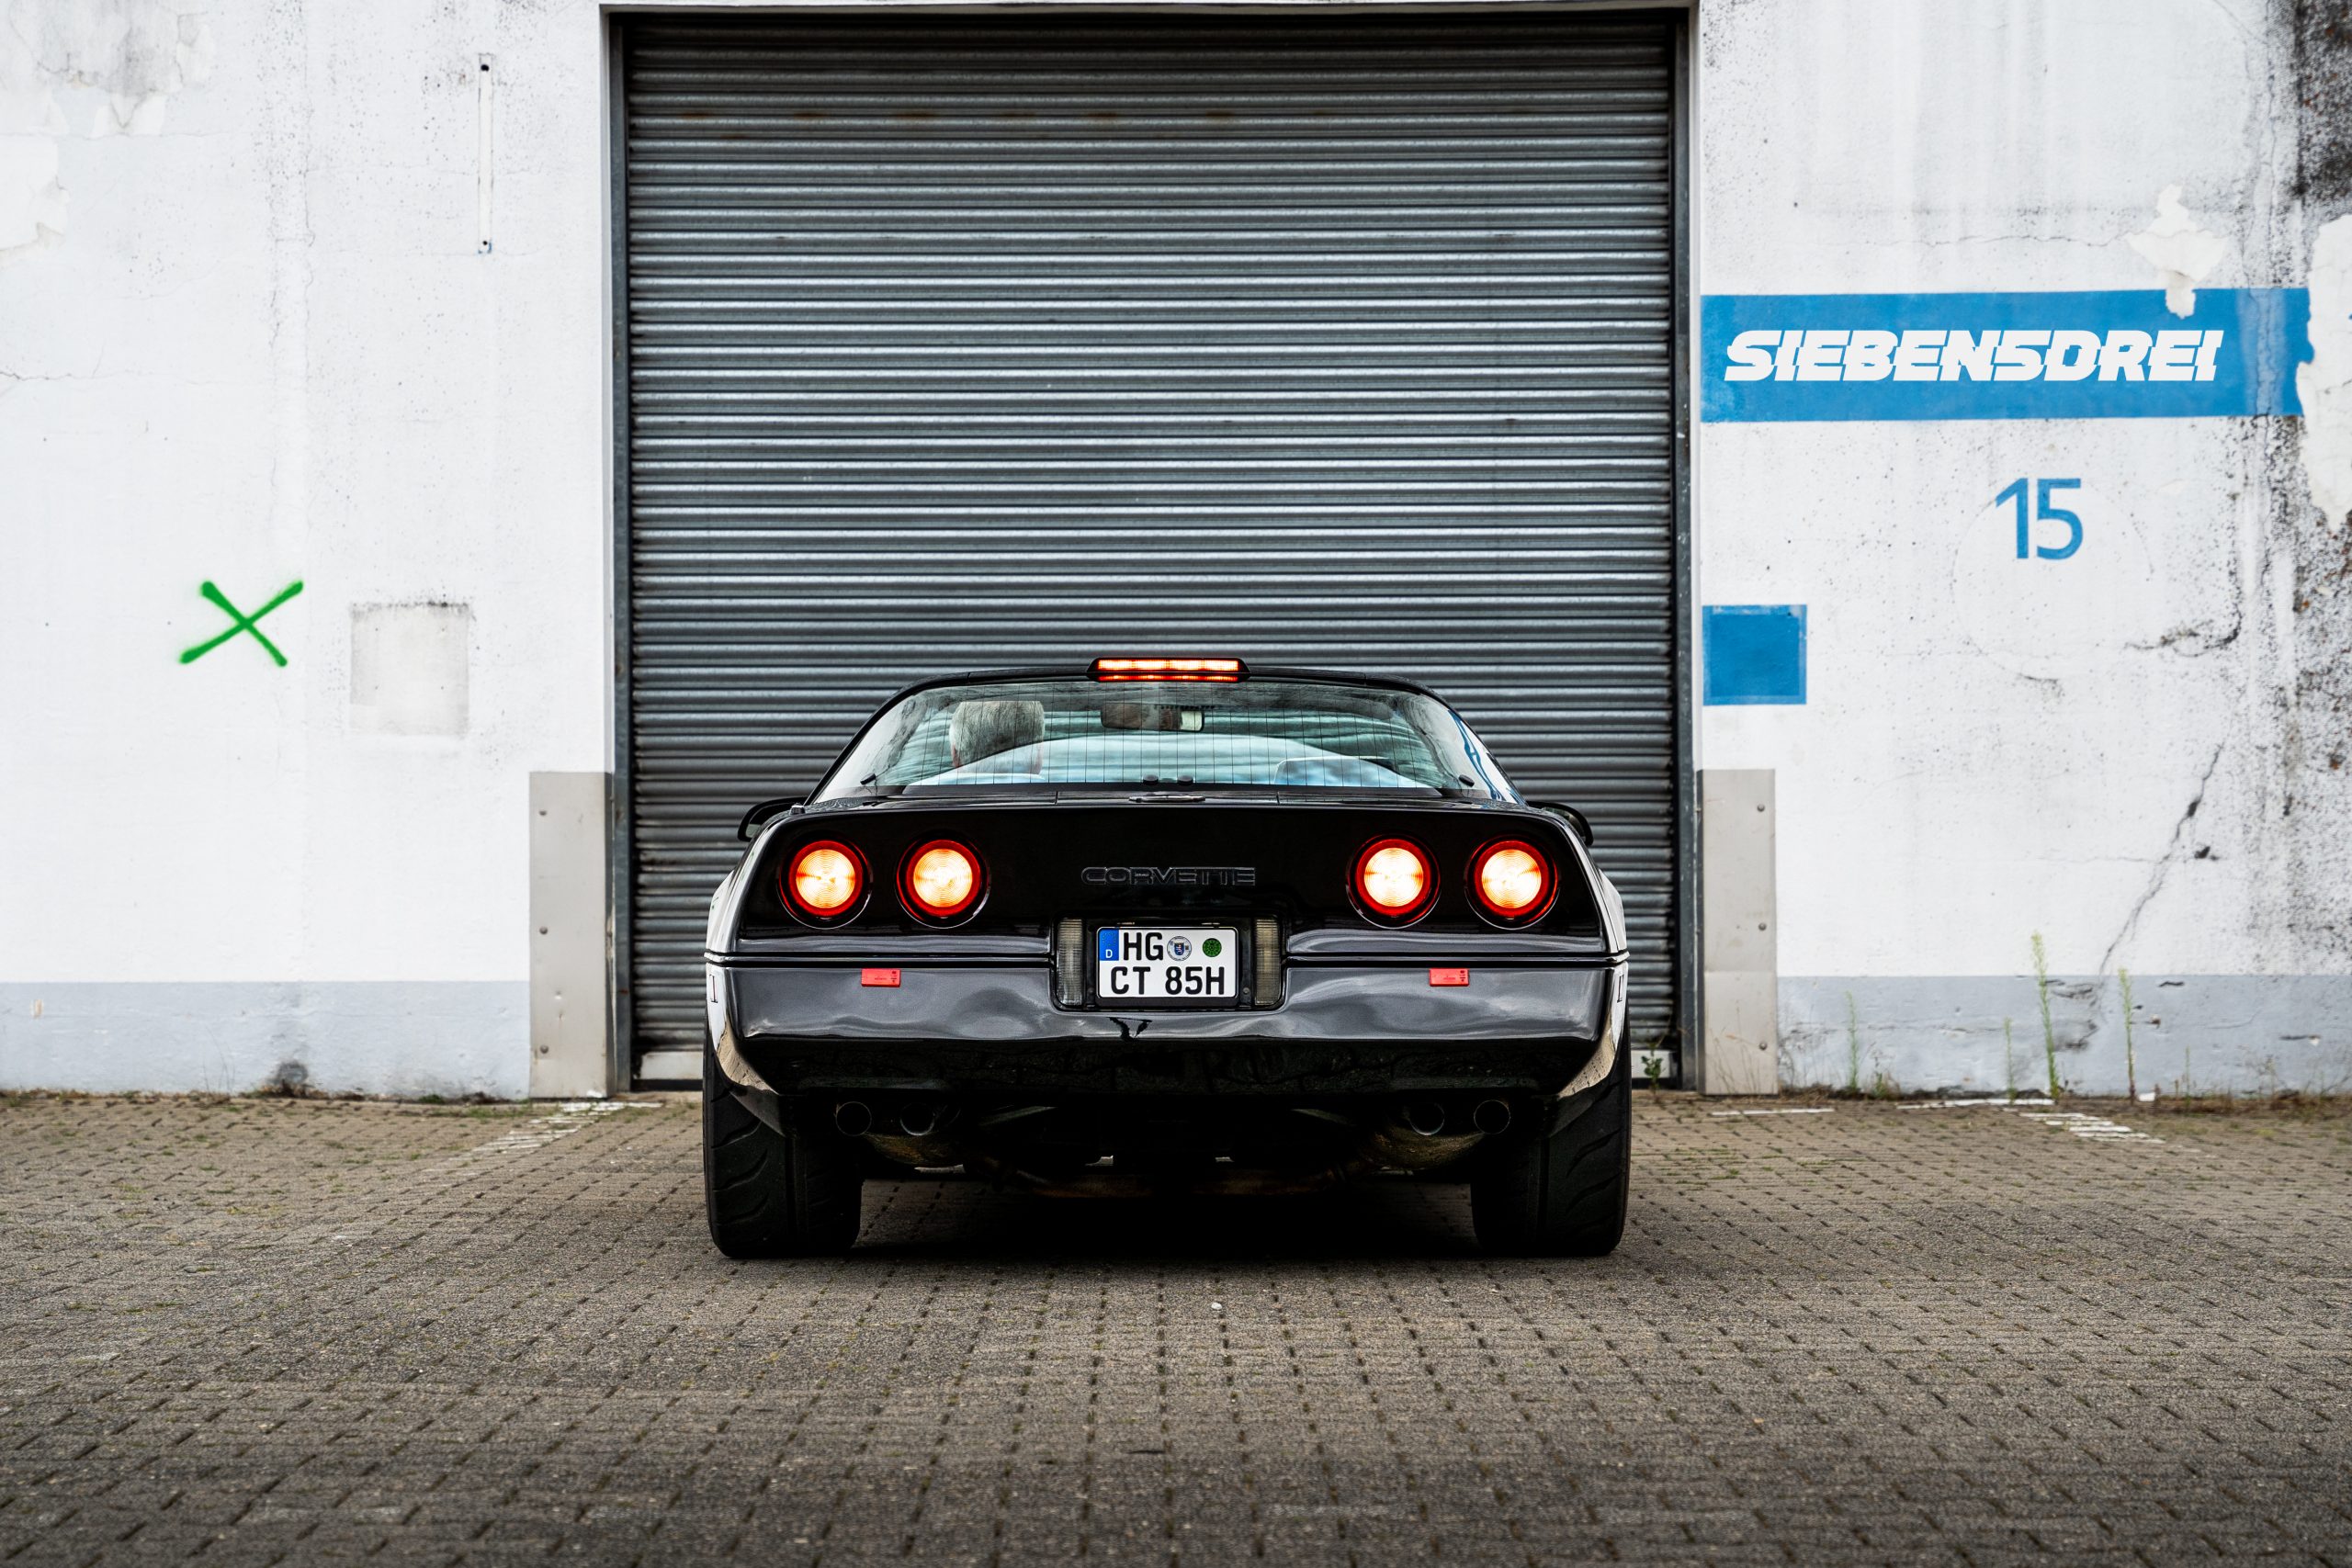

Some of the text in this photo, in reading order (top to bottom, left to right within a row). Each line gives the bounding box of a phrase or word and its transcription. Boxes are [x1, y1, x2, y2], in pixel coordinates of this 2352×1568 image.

[1996, 478, 2083, 559] 15
[1081, 866, 1256, 886] CORVETTE
[1105, 949, 1113, 958] D
[1123, 931, 1164, 961] HG
[1110, 965, 1225, 995] CT 85H
